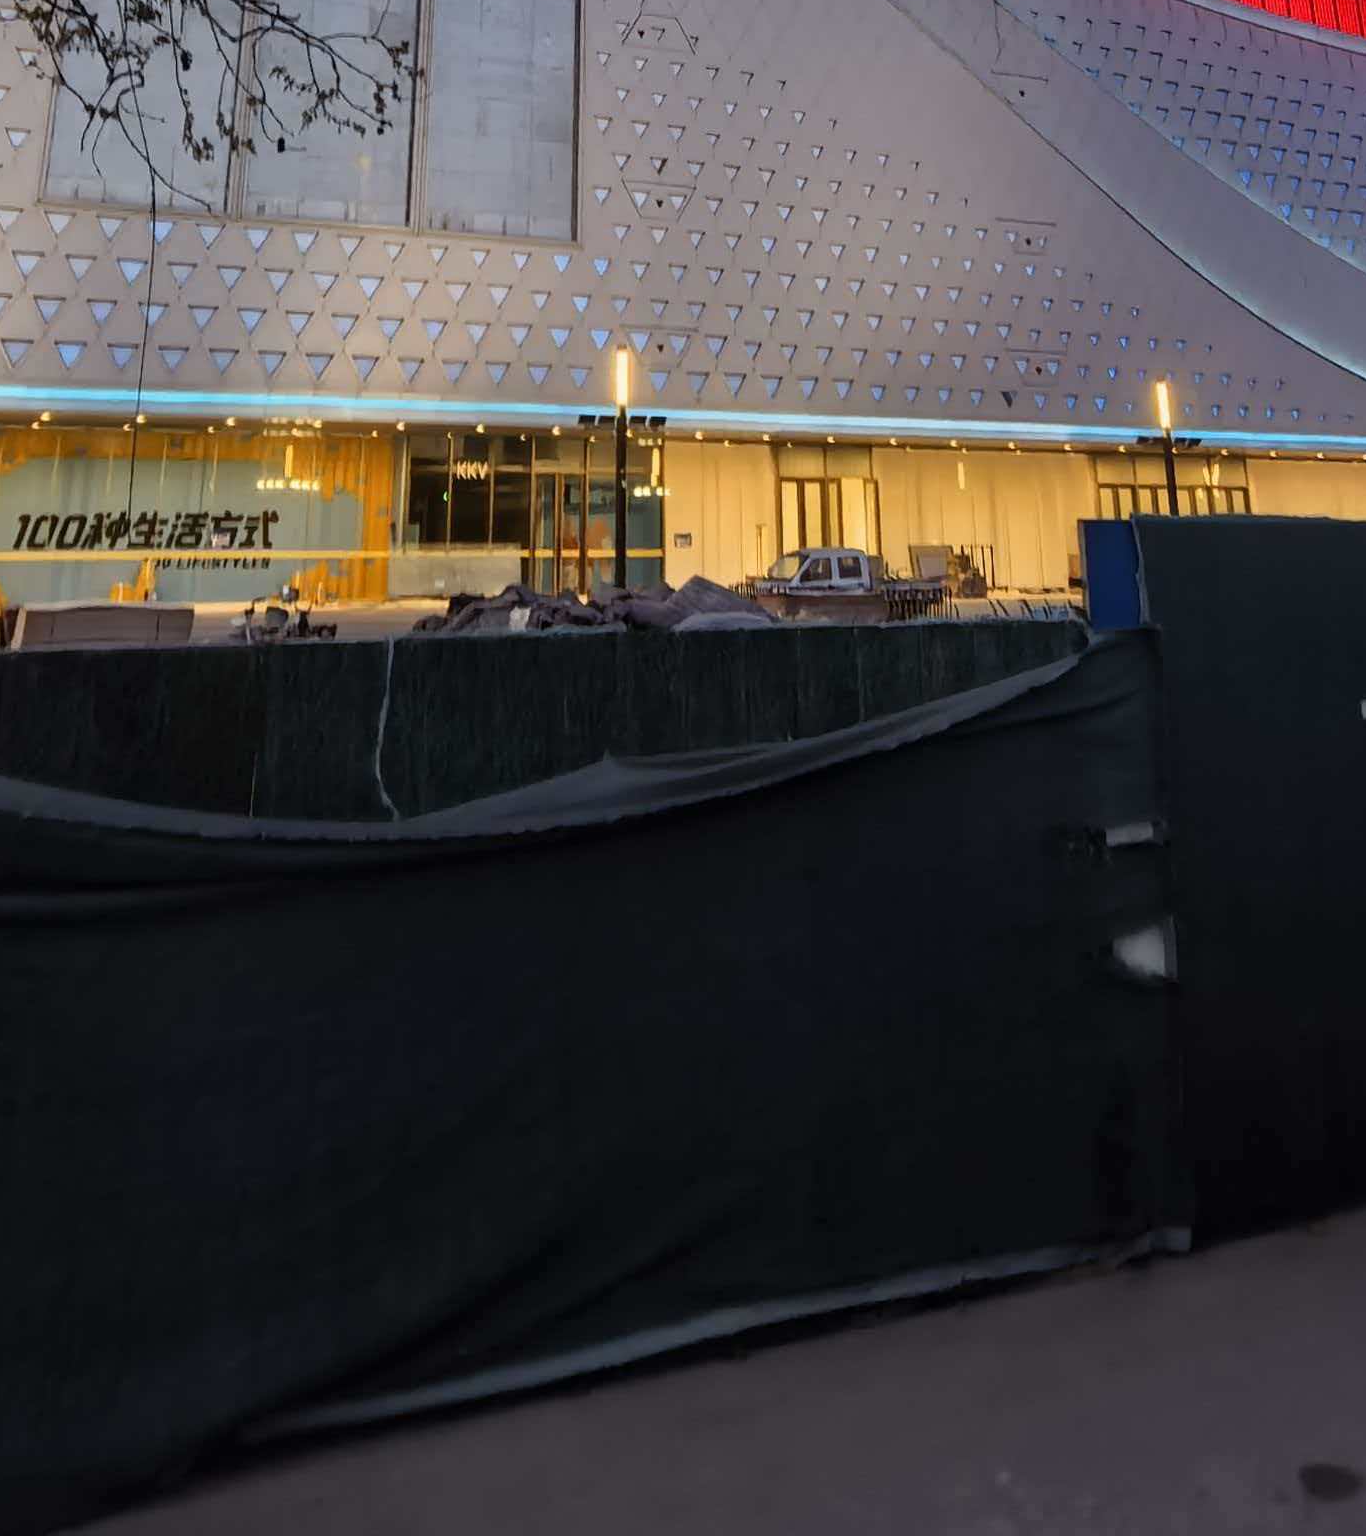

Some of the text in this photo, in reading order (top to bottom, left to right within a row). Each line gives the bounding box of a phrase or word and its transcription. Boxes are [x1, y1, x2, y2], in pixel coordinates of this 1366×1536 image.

[456, 460, 489, 481] KKV
[13, 510, 280, 550] 100种生活方式
